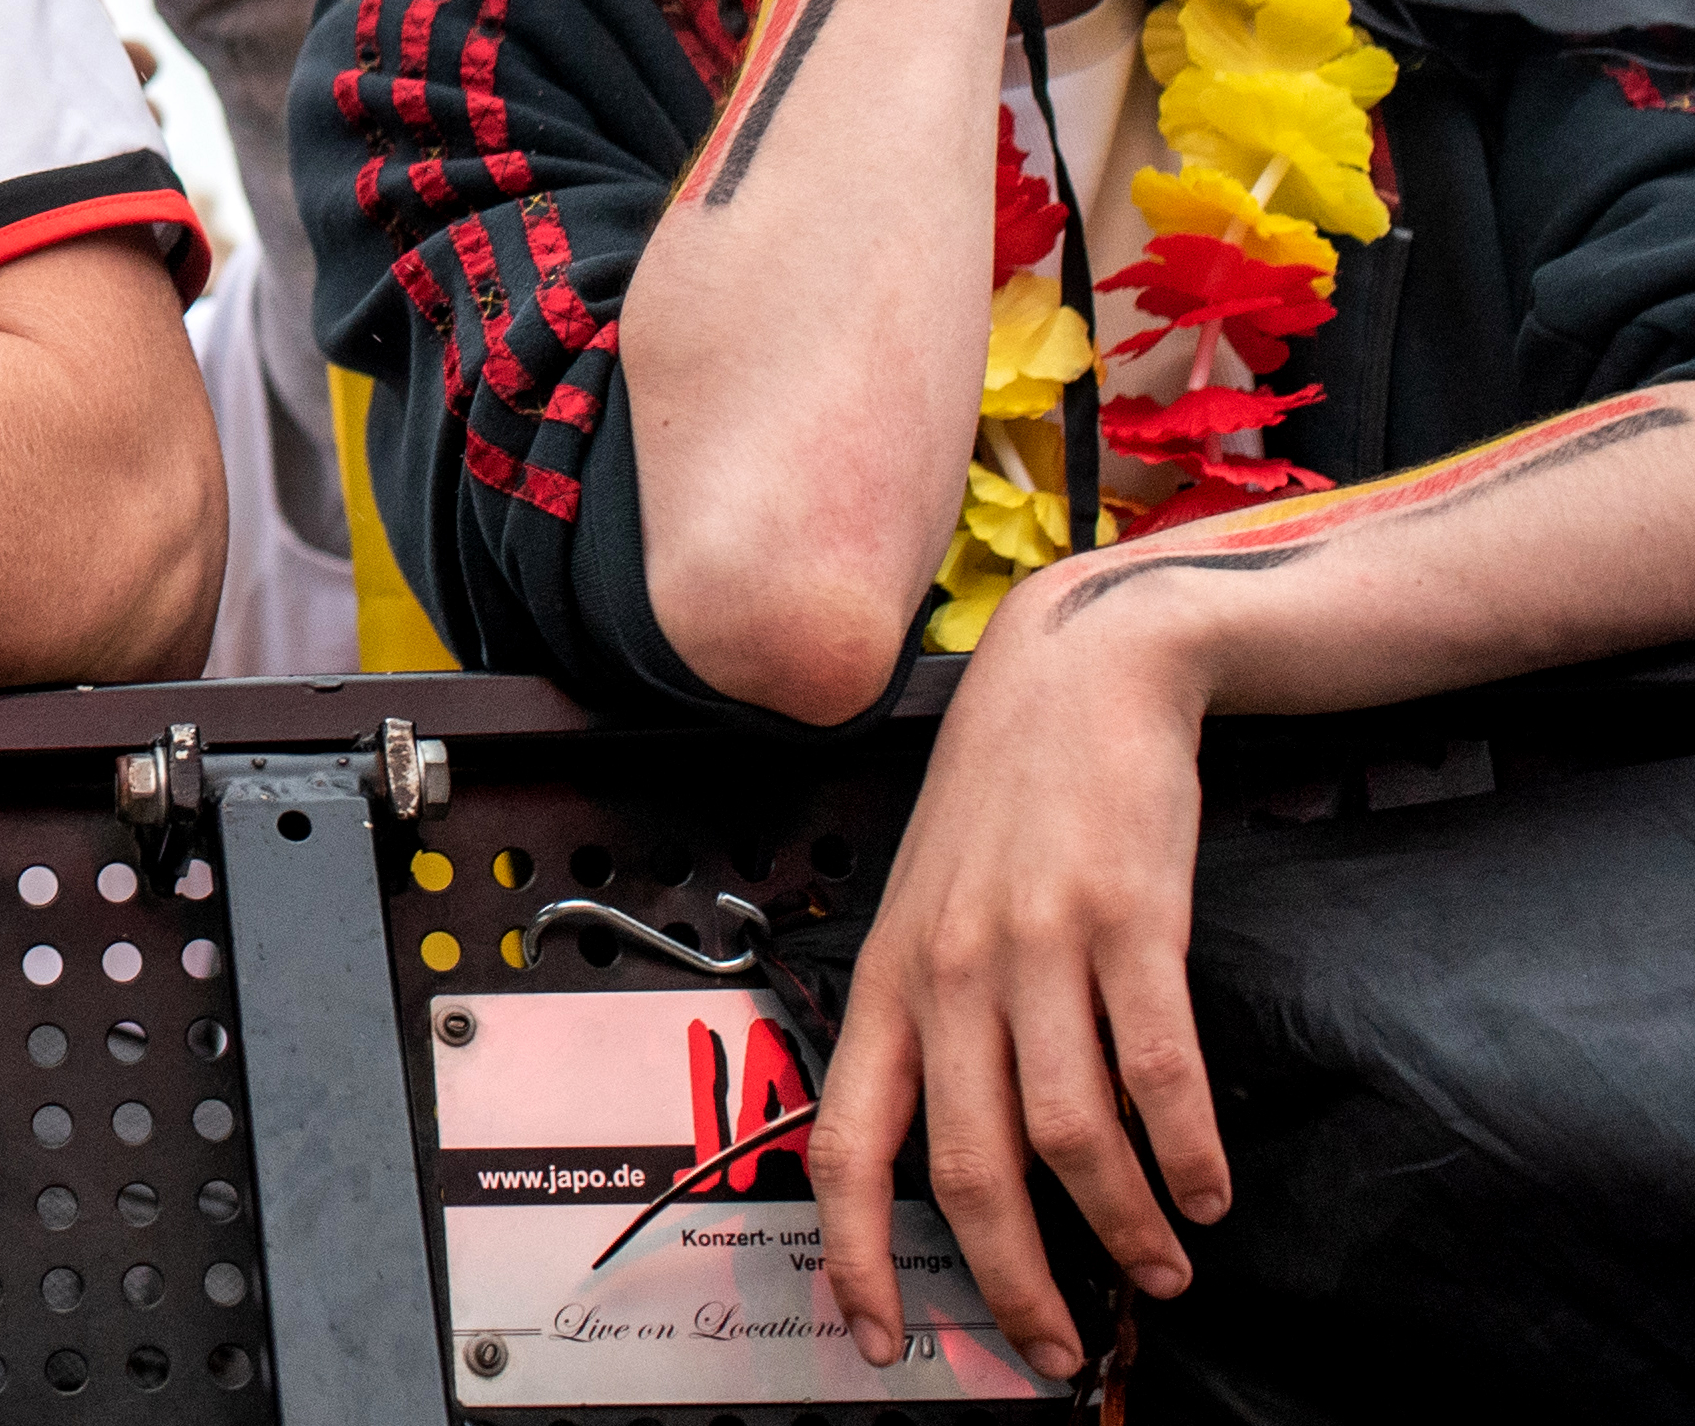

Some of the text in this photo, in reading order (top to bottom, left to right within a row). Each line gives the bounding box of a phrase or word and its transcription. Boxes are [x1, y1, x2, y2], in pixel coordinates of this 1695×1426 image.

[478, 1163, 646, 1194] www.japo.de
[681, 1227, 822, 1248] Konzert- und
[549, 1300, 849, 1344] Live on Locations
